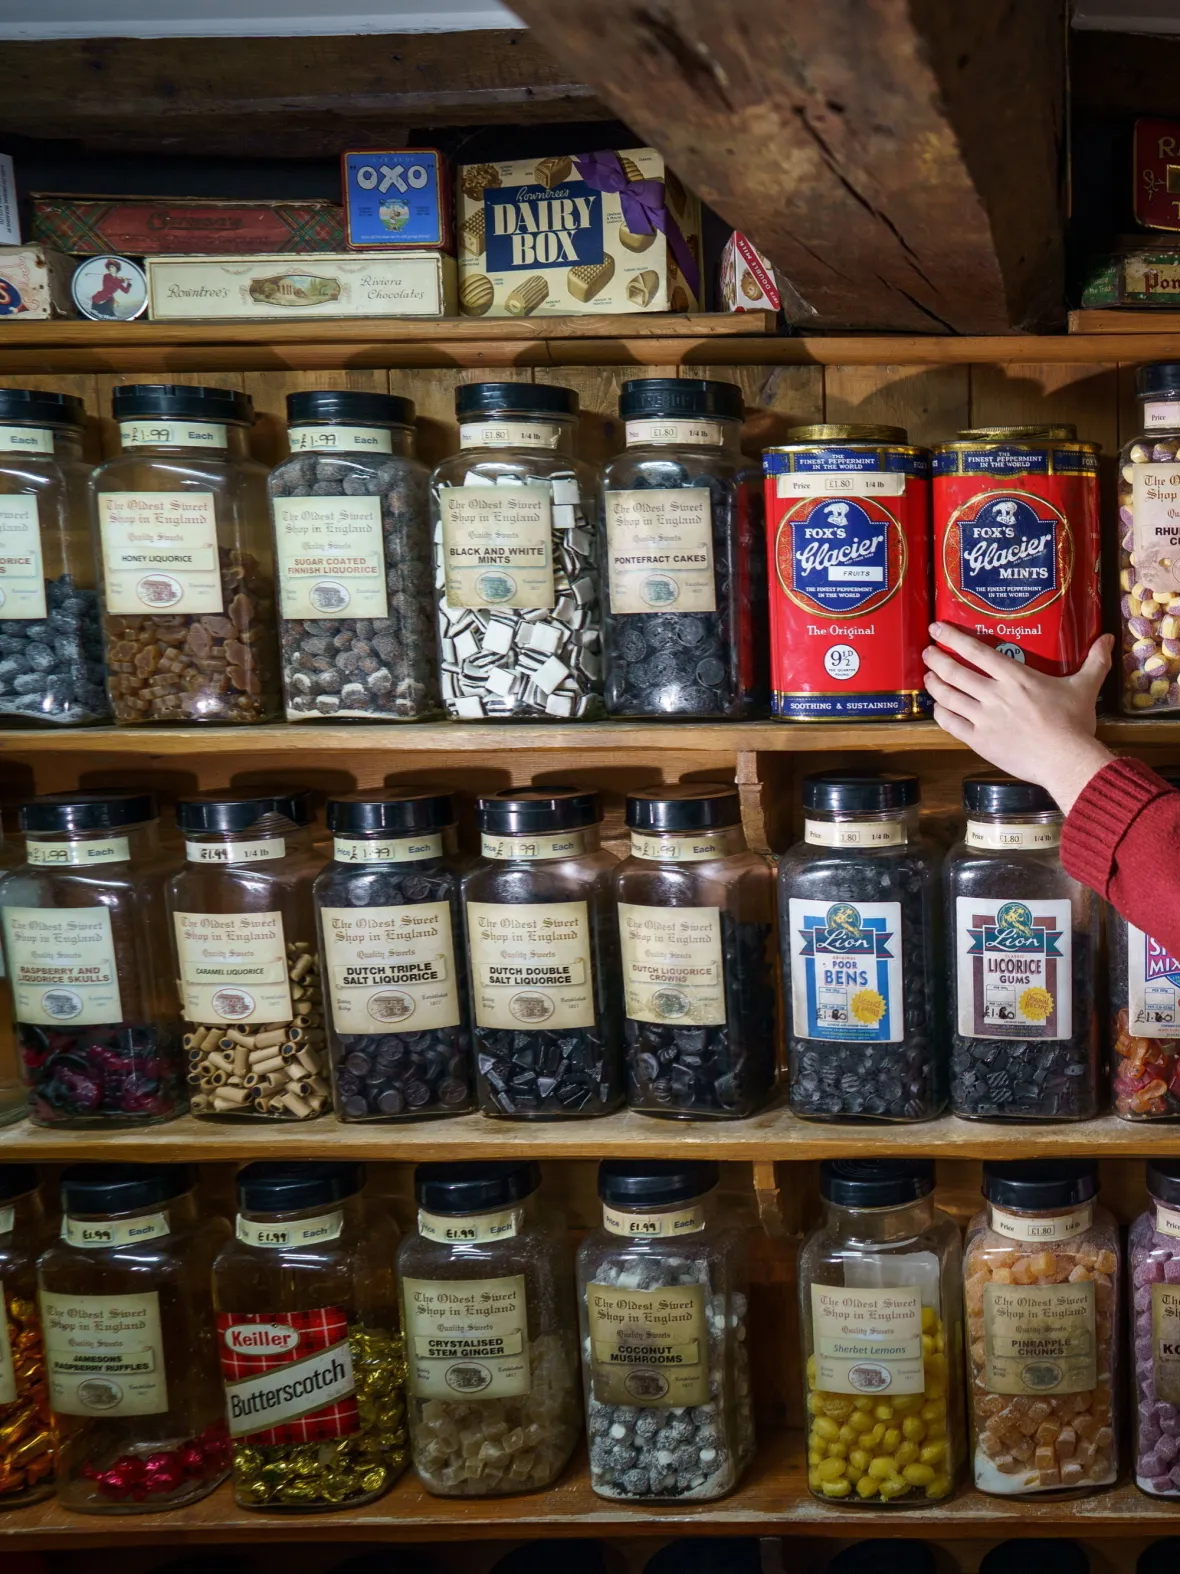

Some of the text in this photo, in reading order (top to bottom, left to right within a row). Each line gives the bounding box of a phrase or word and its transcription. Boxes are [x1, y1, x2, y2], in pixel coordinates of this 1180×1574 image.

[516, 186, 570, 202] Rowntree's
[493, 196, 596, 235] DAIRY
[510, 230, 580, 265] BOX
[739, 240, 770, 290] DOUBLE MILK
[361, 275, 402, 286] Riviera
[167, 283, 231, 299] Rowntree's
[368, 289, 424, 299] Chocolates
[188, 431, 213, 440] Each
[1144, 475, 1166, 490] The
[1145, 488, 1177, 503] Shop
[805, 528, 846, 538] FOX'S
[973, 527, 1014, 538] FOX'S
[615, 556, 669, 564] PONTEFRACT
[796, 535, 884, 576] Glacier
[964, 534, 1052, 576] Glacier
[1000, 568, 1048, 579] MINTS
[807, 625, 875, 638] The Original
[975, 624, 1042, 639] The Original
[817, 929, 869, 952] Lion
[986, 928, 1040, 950] Lion
[20, 966, 74, 975] RASPBERRY
[347, 963, 432, 976] DUTCH TRIPLE
[526, 967, 569, 975] DOUBLE
[633, 964, 658, 974] DUTCH
[988, 958, 1041, 973] LICORICE
[18, 974, 64, 983] LIQUORICE
[344, 972, 437, 984] SALT LIQUORICE
[825, 971, 868, 986] BENS
[1000, 975, 1030, 984] GUMS
[1024, 1002, 1048, 1012] RECIPE
[446, 1229, 475, 1238] £1.99
[232, 1331, 291, 1347] Keiller
[429, 1339, 503, 1348] CRYSTALISED
[1012, 1339, 1071, 1348] PINEAPPLE
[429, 1348, 504, 1356] STEM GINGER
[618, 1346, 672, 1354] COCONUT
[834, 1344, 905, 1354] Sherbet Lemons
[611, 1354, 682, 1364] MUSHROOMS
[55, 1362, 103, 1371] RASPBERRY
[230, 1359, 345, 1418] Butterscotch
